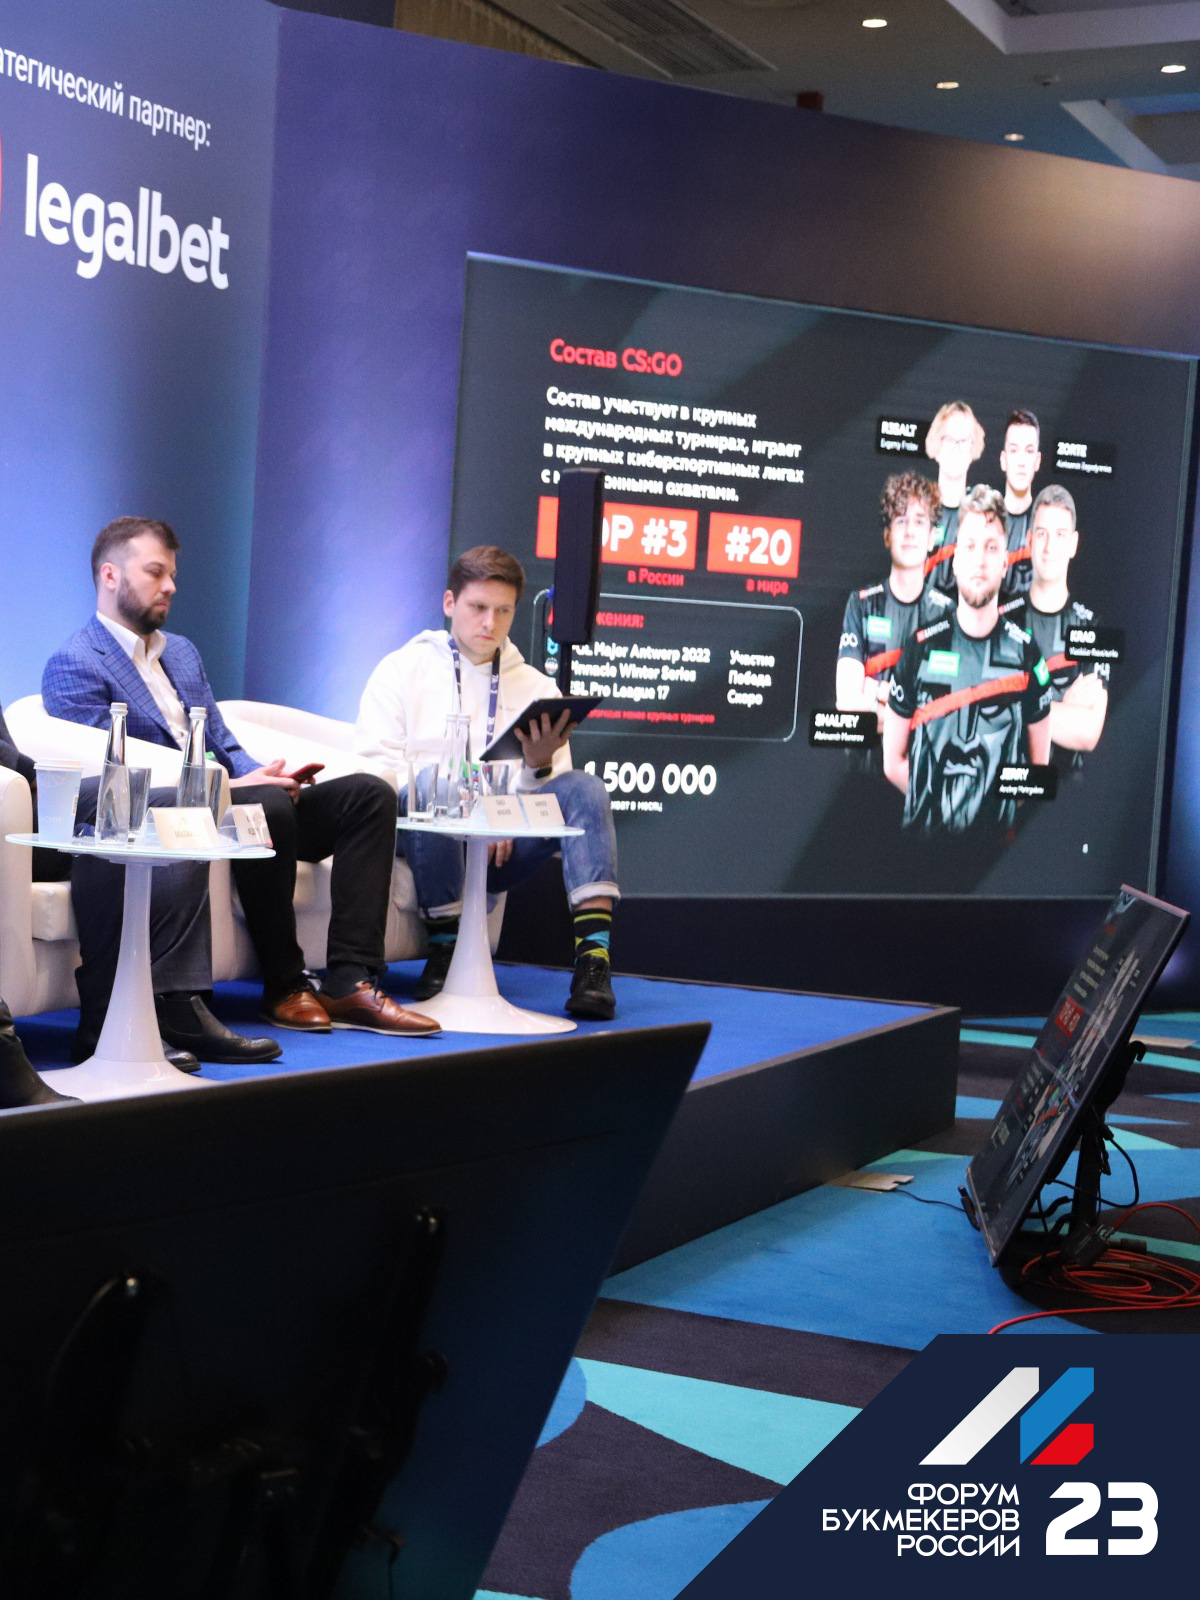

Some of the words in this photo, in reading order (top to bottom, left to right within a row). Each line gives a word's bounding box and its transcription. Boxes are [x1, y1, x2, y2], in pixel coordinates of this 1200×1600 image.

[129, 94, 211, 150] партнер:
[25, 153, 230, 290] legalbet
[550, 338, 617, 369] Состав
[622, 347, 683, 377] CS:GO
[546, 386, 601, 410] Состав
[603, 396, 679, 421] участвует
[680, 405, 690, 420] в
[692, 406, 757, 428] крупных
[545, 416, 673, 445] международных
[676, 430, 749, 456] турнирах,
[752, 439, 802, 459] играет
[543, 443, 553, 458] в
[555, 444, 624, 465] крупных
[627, 449, 760, 479] киберспортивных
[762, 465, 804, 484] лигах
[641, 518, 688, 557] #3
[724, 525, 792, 566] #20
[627, 571, 636, 584] в
[639, 568, 684, 587] России
[757, 580, 789, 596] мире
[594, 642, 628, 661] Major
[630, 644, 680, 664] Antwerp
[682, 647, 710, 664] 2022
[729, 650, 775, 668] Участие
[619, 663, 660, 680] Winter
[661, 665, 696, 682] Series
[728, 669, 772, 688] Победа
[590, 681, 611, 697] Pro
[613, 683, 655, 702] League
[657, 685, 670, 700] 17
[727, 689, 763, 707] Скоро
[603, 761, 656, 794] 500
[662, 763, 717, 796] 000
